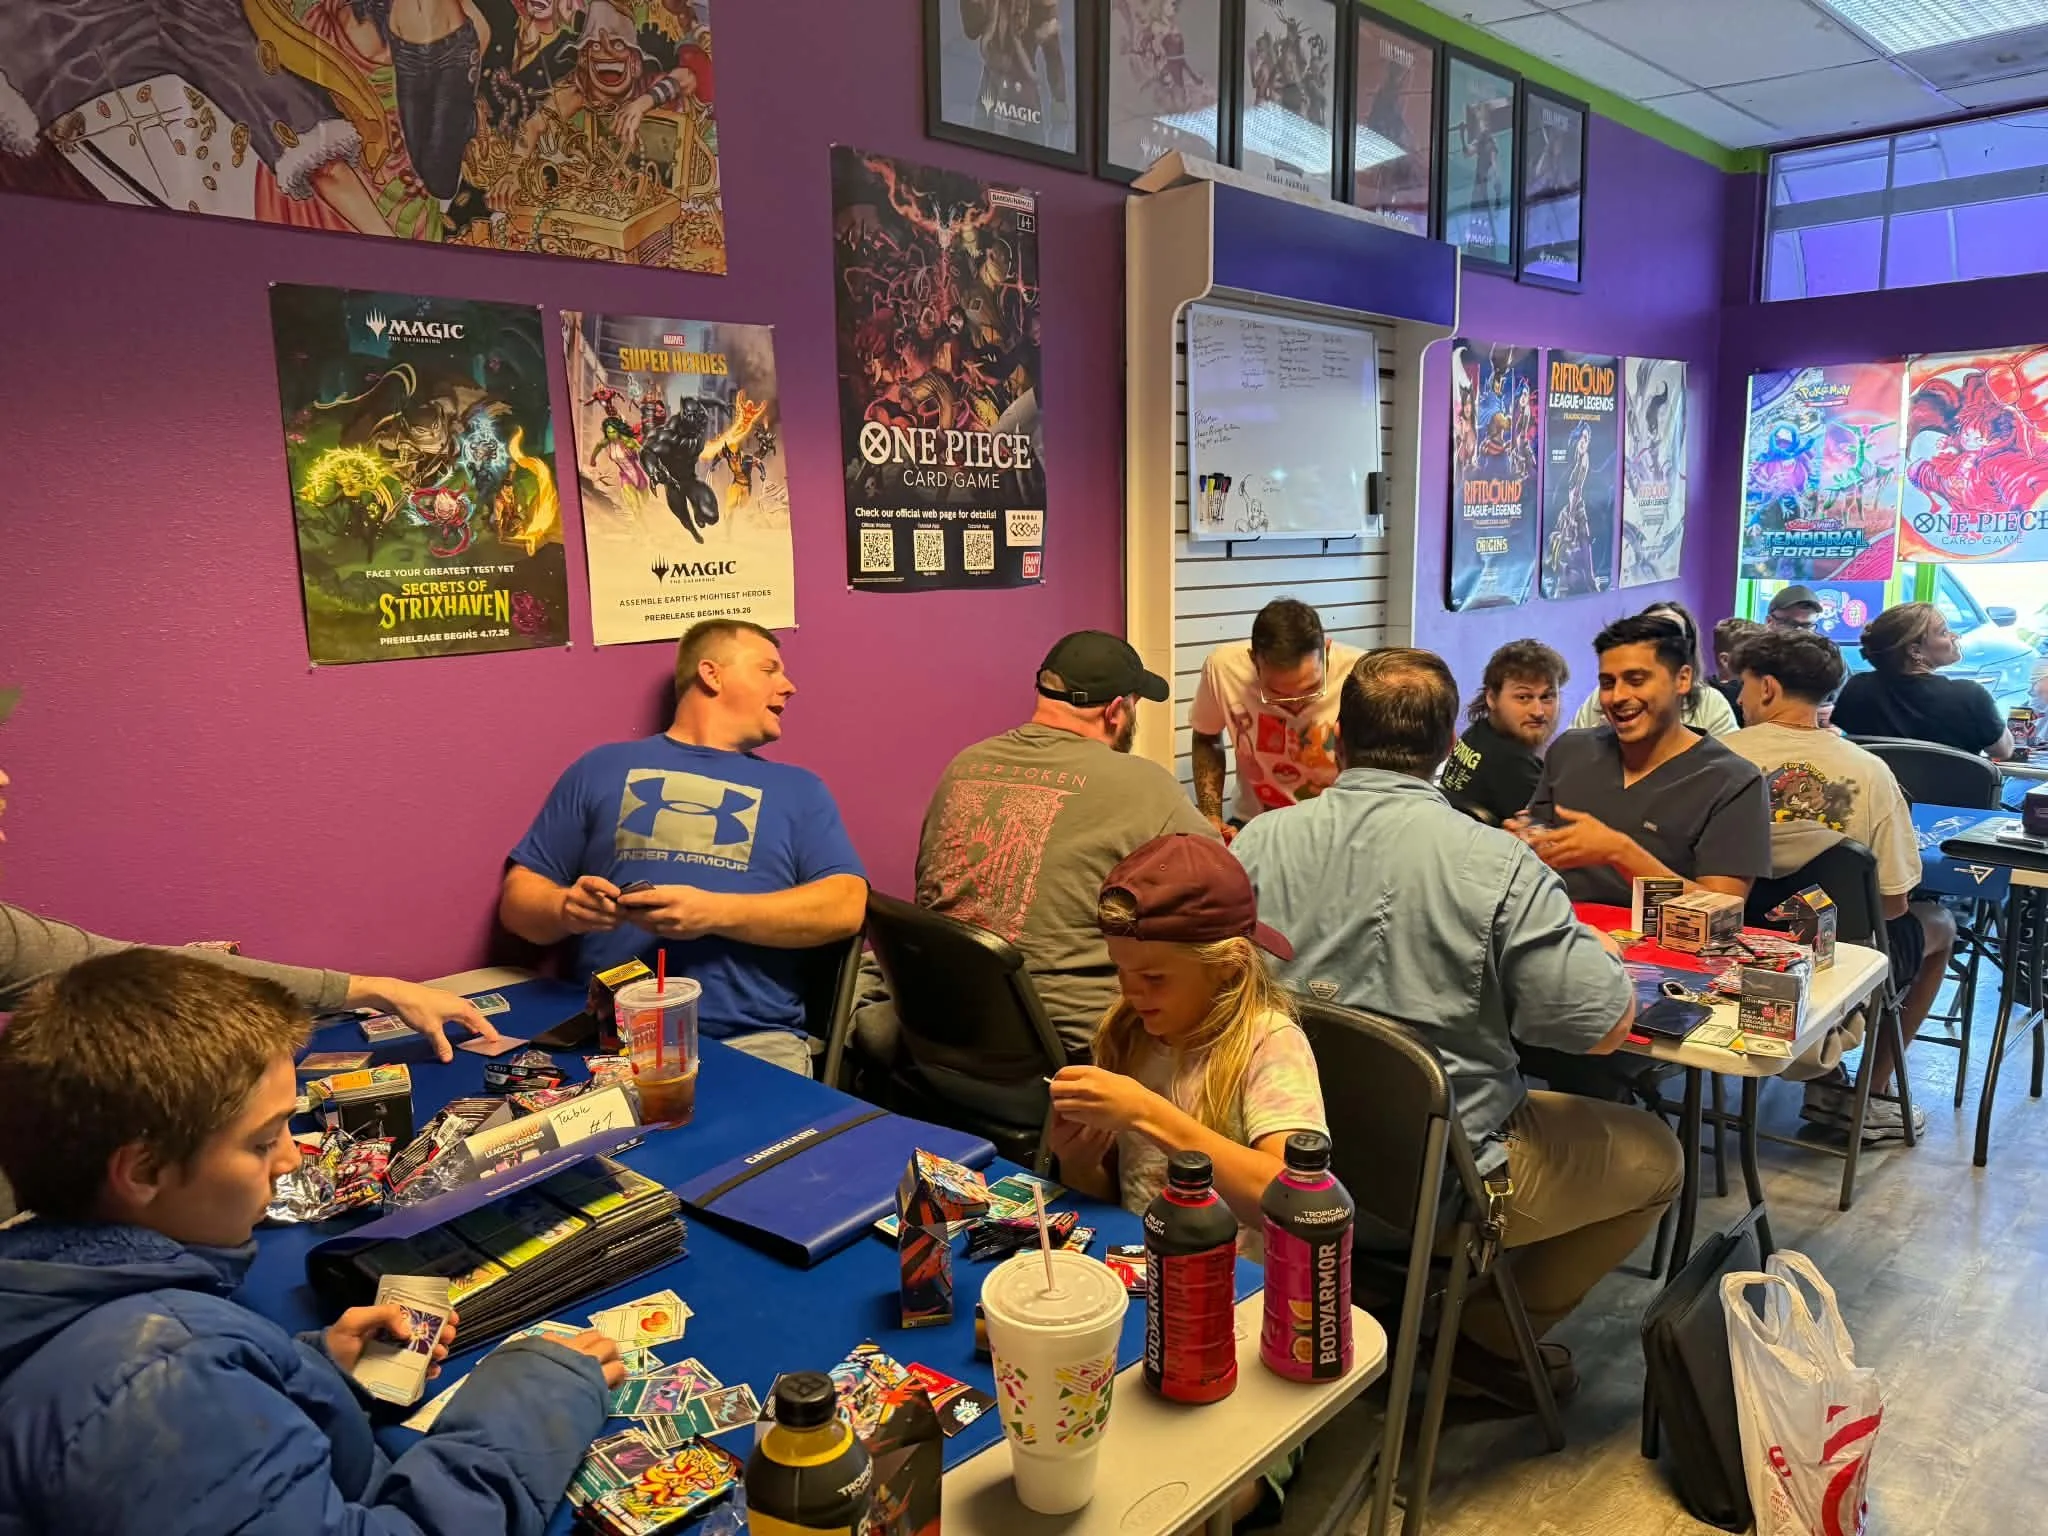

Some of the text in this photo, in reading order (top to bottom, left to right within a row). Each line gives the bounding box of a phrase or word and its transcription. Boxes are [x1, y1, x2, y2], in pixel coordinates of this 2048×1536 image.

[994, 100, 1041, 124] MAGIC
[388, 320, 465, 339] MAGIC
[619, 347, 728, 376] SUPER HEROES
[1551, 361, 1614, 396] RIFTBOUND
[1549, 393, 1579, 409] LEAGUE
[1583, 395, 1614, 411] LEGENDS
[859, 421, 1032, 470] ONE PIECE
[903, 470, 1001, 489] CARD GAME
[1464, 479, 1522, 505] RIFTBOUND
[855, 507, 997, 520] Check our official web page for details!
[1463, 504, 1488, 517] LEAGUE
[1491, 504, 1522, 517] LEGENDS
[1913, 512, 1969, 533] ONE
[1763, 530, 1868, 546] TEMPORAL
[1942, 535, 2024, 545] CARD GAME
[1772, 546, 1855, 557] FORCES
[366, 565, 515, 578] FACE YOUR GREATEST TEST YET
[670, 560, 737, 577] MAGIC
[401, 580, 488, 596] SECRETS OF
[620, 589, 772, 607] ASSEMBLE EARTH'S MIGHTIEST HEROES
[378, 590, 510, 630] STRIXHAVEN
[645, 612, 695, 621] PRERELEASE
[380, 633, 443, 646] PRERELEASE
[444, 630, 478, 640] BEGINS
[1011, 765, 1088, 789] TOKEN
[673, 853, 749, 872] ARMOUR
[744, 1128, 819, 1164] CARDGUARD
[1147, 1213, 1166, 1227] FRUIT
[1294, 1207, 1350, 1225] PASSIONFRUIT
[1303, 1205, 1344, 1218] TROPICAL
[1144, 1218, 1165, 1236] PUNCH
[1146, 1249, 1161, 1374] BODYARMOR
[1318, 1241, 1337, 1365] BODYARMOR
